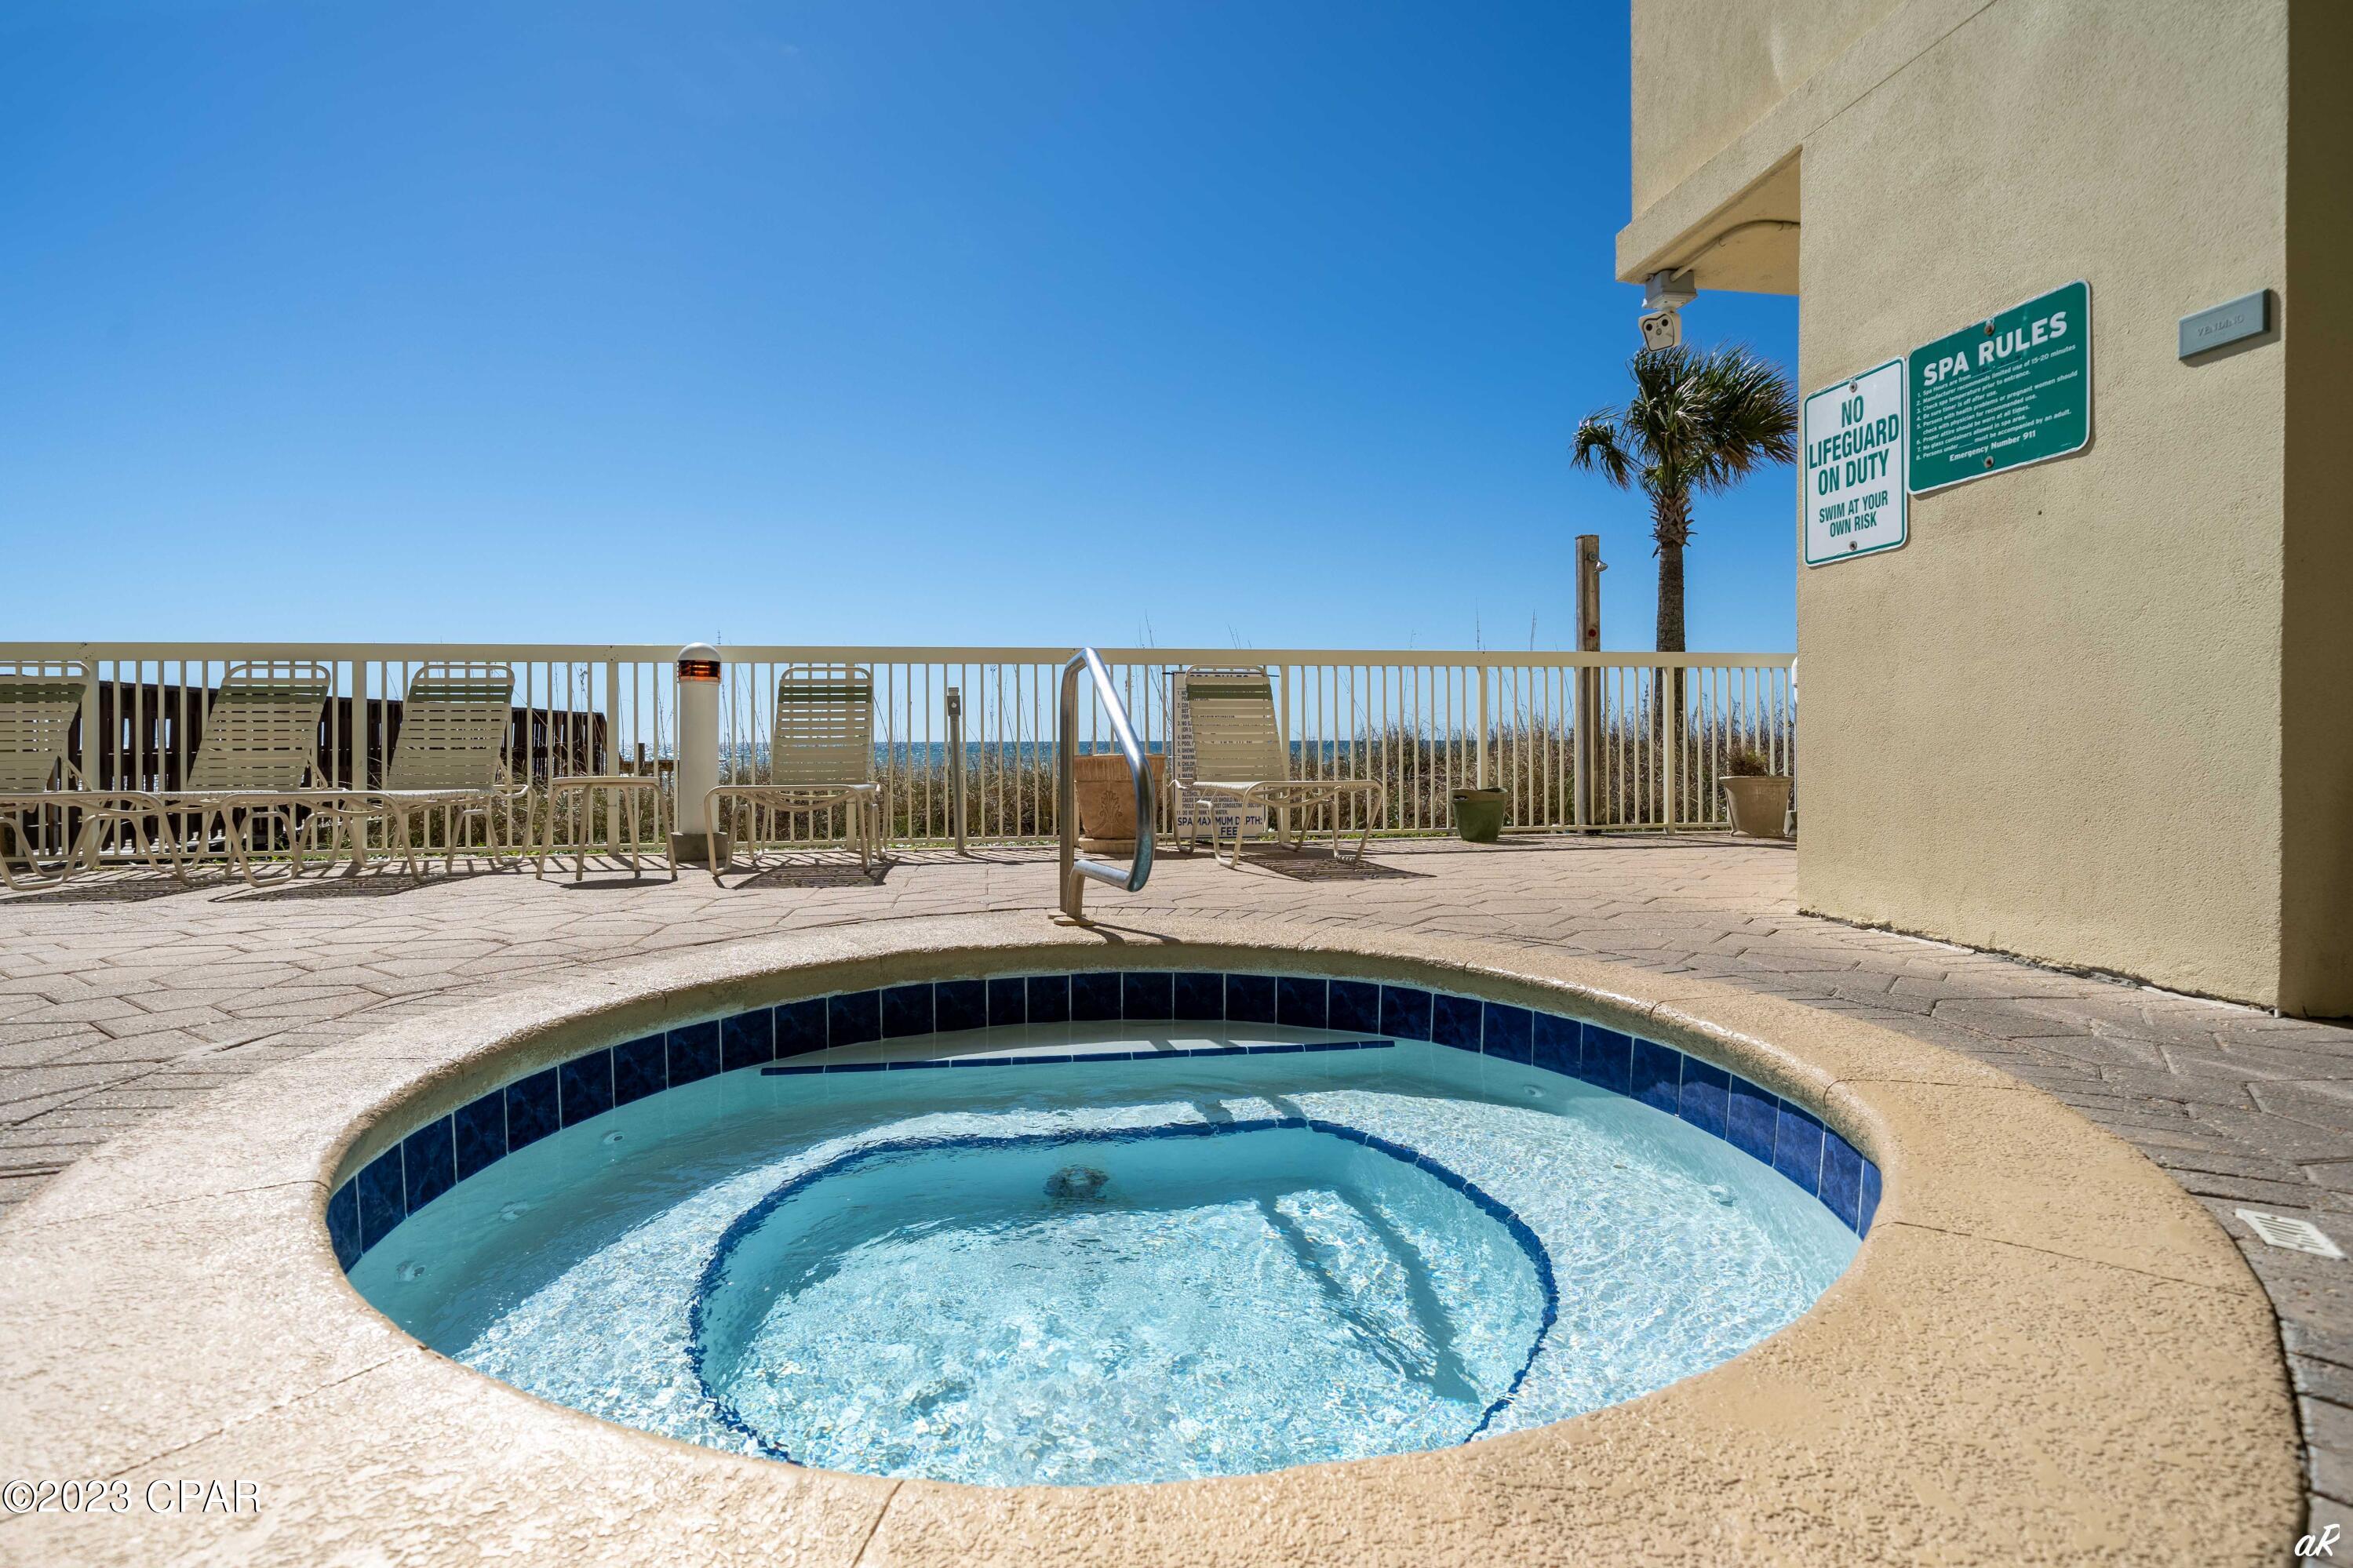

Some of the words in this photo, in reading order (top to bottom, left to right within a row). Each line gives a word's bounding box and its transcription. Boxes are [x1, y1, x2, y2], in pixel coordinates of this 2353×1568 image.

[1924, 351, 1969, 387] SPA
[1979, 311, 2067, 366] RULES
[1923, 388, 1956, 404] Manufacturer
[1957, 375, 1991, 391] recommends
[1992, 367, 2011, 378] limited
[2031, 353, 2049, 364] 15-20
[2050, 344, 2076, 358] minutes
[1923, 402, 1938, 411] Check
[1949, 387, 1981, 402] temperature
[1982, 382, 1995, 391] prior
[2004, 370, 2031, 383] entrance.
[1933, 383, 1948, 391] Hours
[1958, 374, 1971, 382] from
[1841, 395, 1864, 428] NO
[1923, 417, 1943, 427] Persons
[1956, 407, 1972, 416] health
[1974, 398, 1998, 411] problems
[2007, 386, 2033, 400] pregnant
[2034, 378, 2056, 389] women
[2056, 370, 2078, 382] should
[1951, 415, 1975, 427] physician
[1985, 397, 2024, 414] recommended
[1923, 434, 1940, 442] Proper
[1956, 423, 1973, 432] should
[2012, 405, 2031, 414] times.
[1923, 449, 1943, 458] Persons
[1974, 434, 1989, 443] must
[1998, 420, 2034, 435] accompanied
[2054, 409, 2072, 418] adult.
[1931, 440, 1944, 449] glass
[1945, 432, 1972, 444] containers
[1973, 424, 1993, 435] allowed
[2012, 415, 2027, 423] area.
[1809, 413, 1900, 469] LIFEGUARD
[1949, 446, 1989, 462] Emergency
[1991, 435, 2021, 450] Number
[2023, 429, 2036, 440] 911
[1818, 464, 1840, 496] ON
[1845, 449, 1890, 489] DUTY
[1819, 502, 1845, 524] SWIM
[1848, 498, 1860, 516] AT
[1862, 490, 1889, 512] YOUR
[1830, 517, 1852, 538] OWN
[1854, 511, 1878, 532] RISK
[1178, 817, 1193, 826] SPA
[1236, 816, 1262, 825] DPTH:
[1221, 827, 1238, 835] FEE
